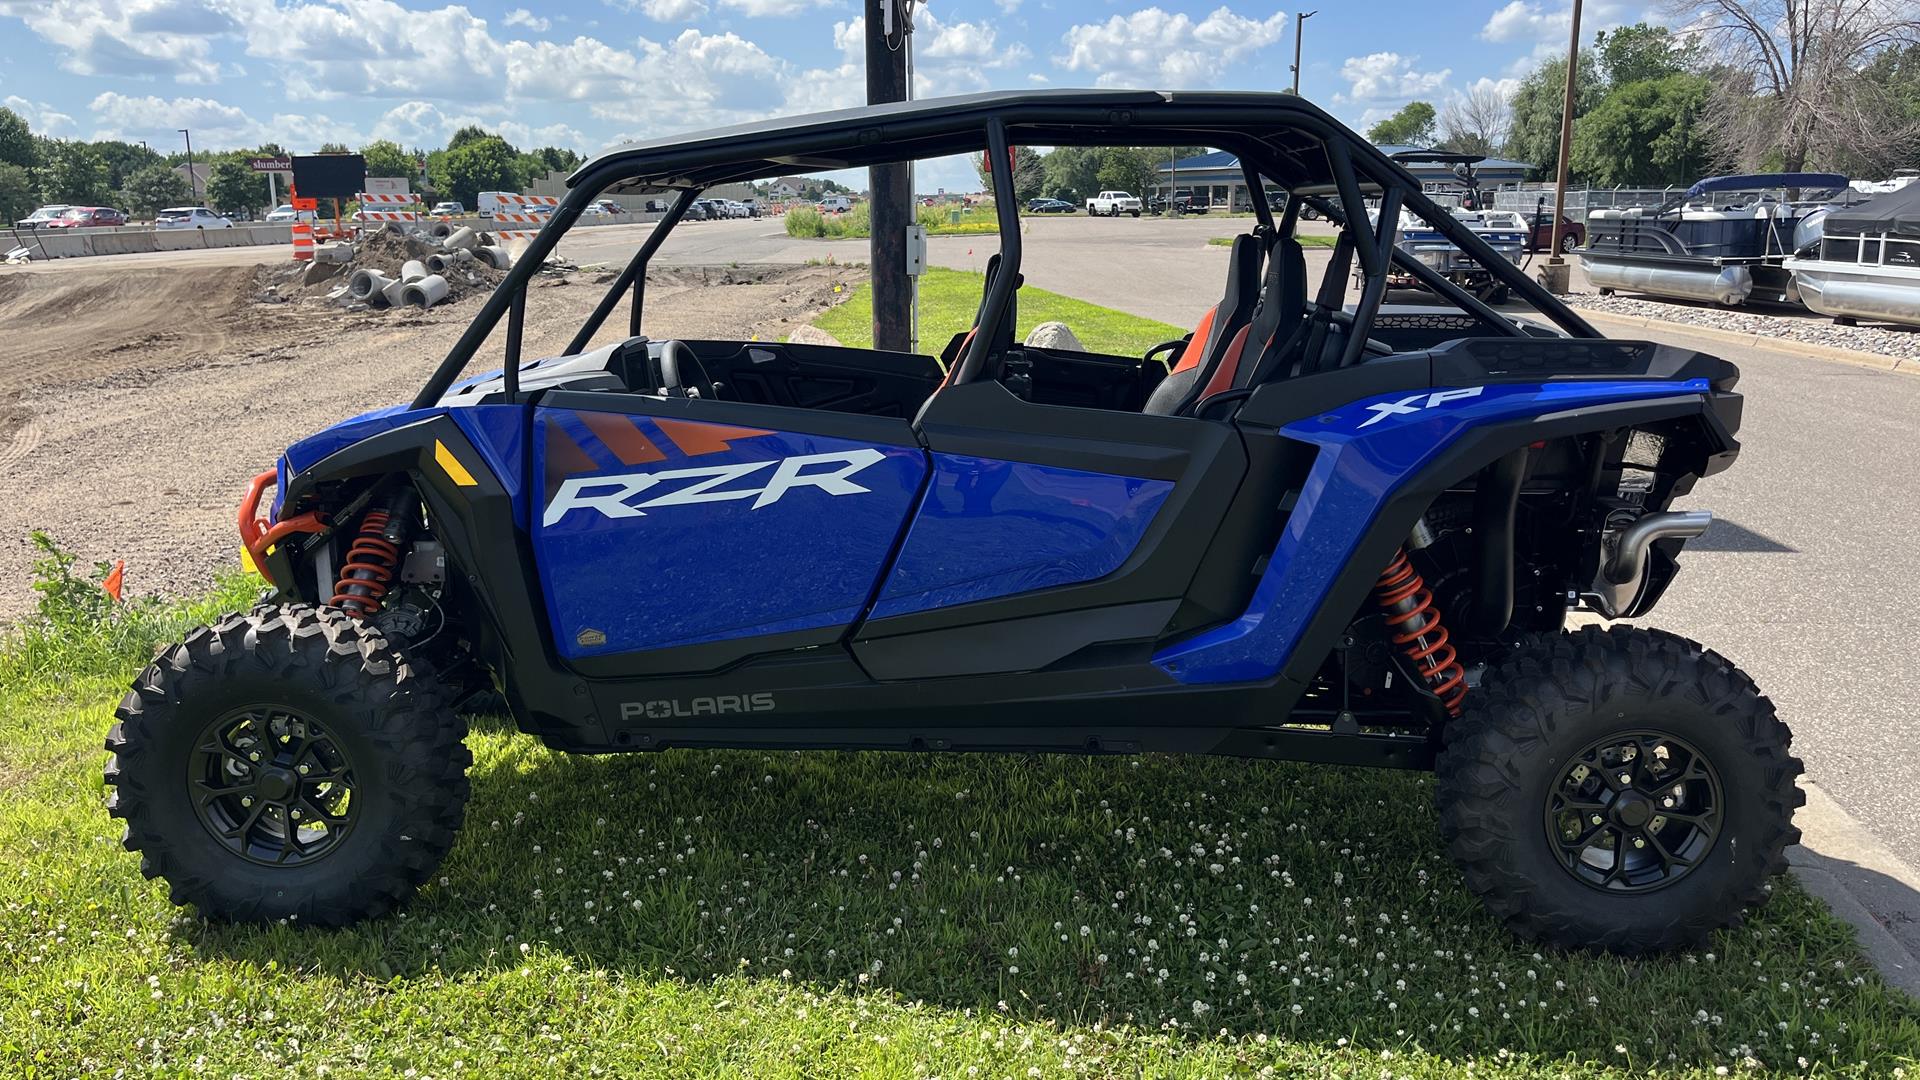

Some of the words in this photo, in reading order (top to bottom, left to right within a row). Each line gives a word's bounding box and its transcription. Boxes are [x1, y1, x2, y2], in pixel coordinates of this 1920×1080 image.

[253, 160, 291, 169] slumber
[1356, 386, 1484, 429] XP
[543, 448, 887, 528] RZR
[620, 692, 776, 721] POLARIS
